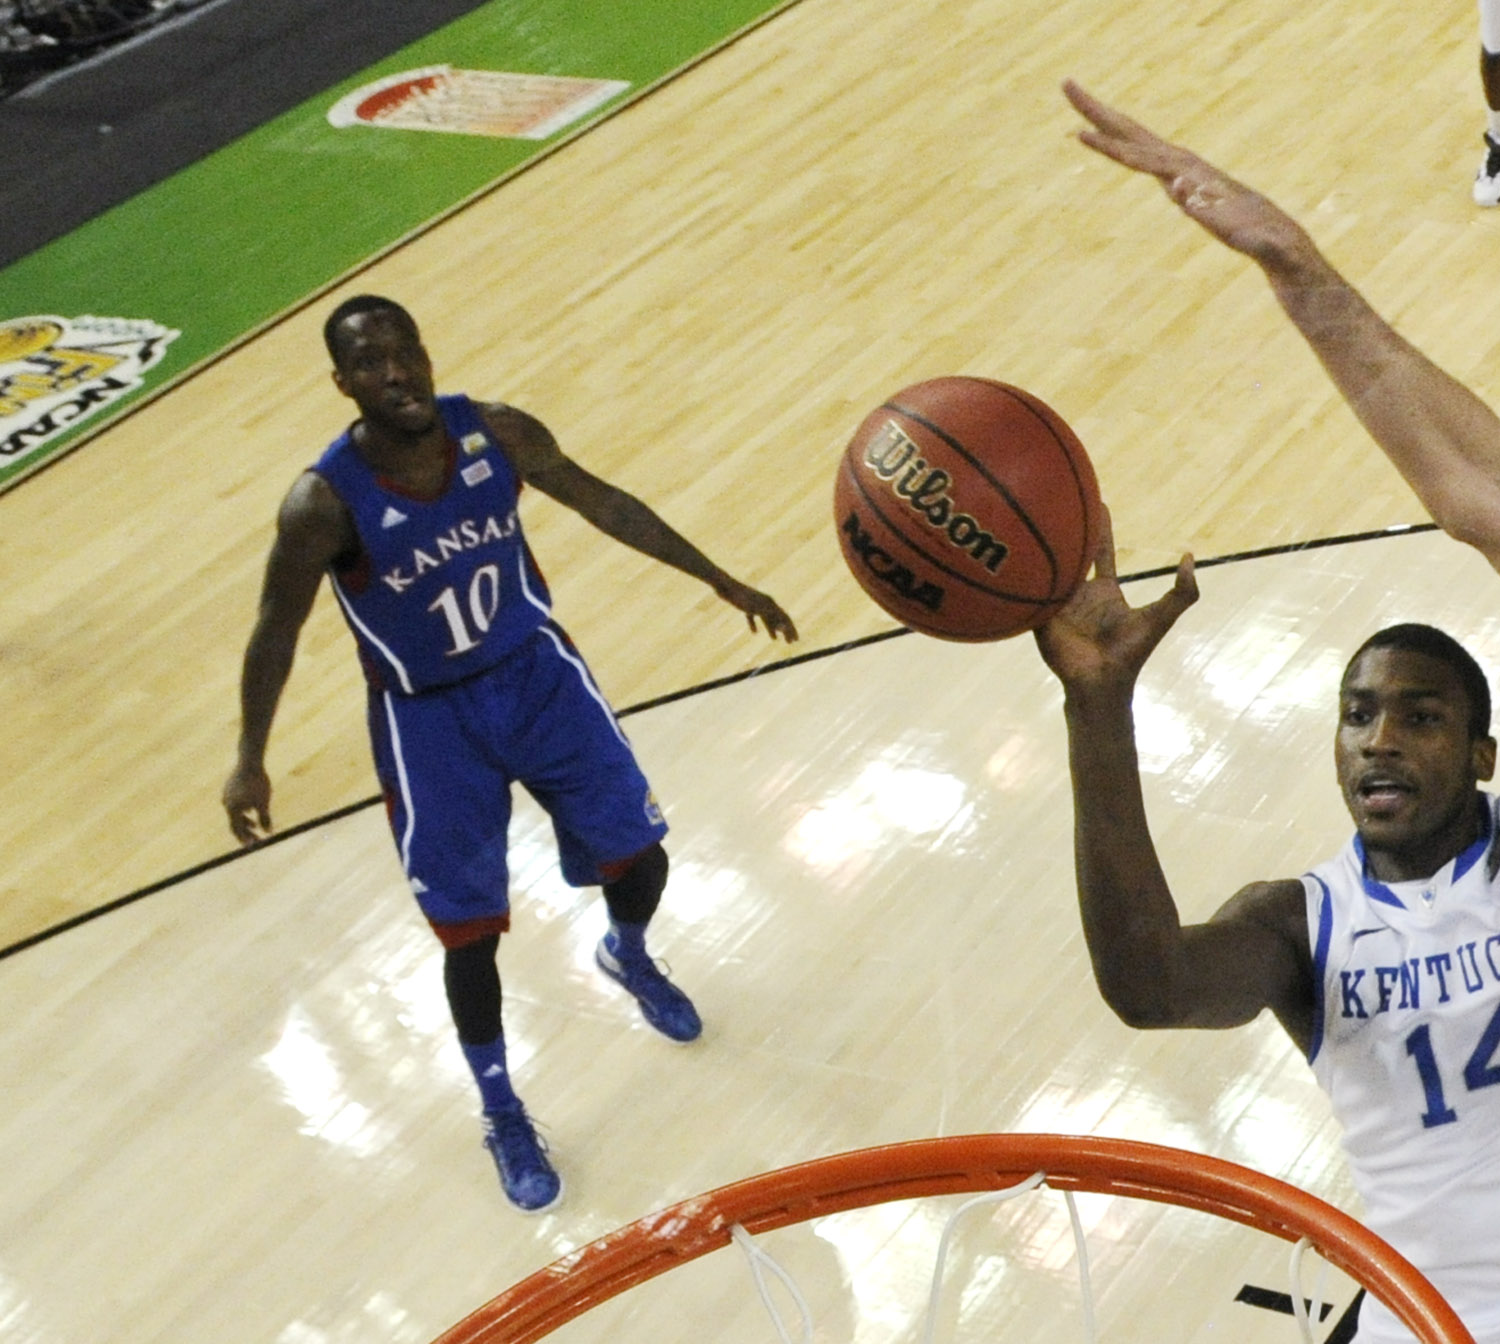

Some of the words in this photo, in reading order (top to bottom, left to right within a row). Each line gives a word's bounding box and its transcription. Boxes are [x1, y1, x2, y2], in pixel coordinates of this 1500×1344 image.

[864, 419, 1010, 575] Wilson
[427, 564, 499, 657] 10
[841, 512, 945, 613] NCAA
